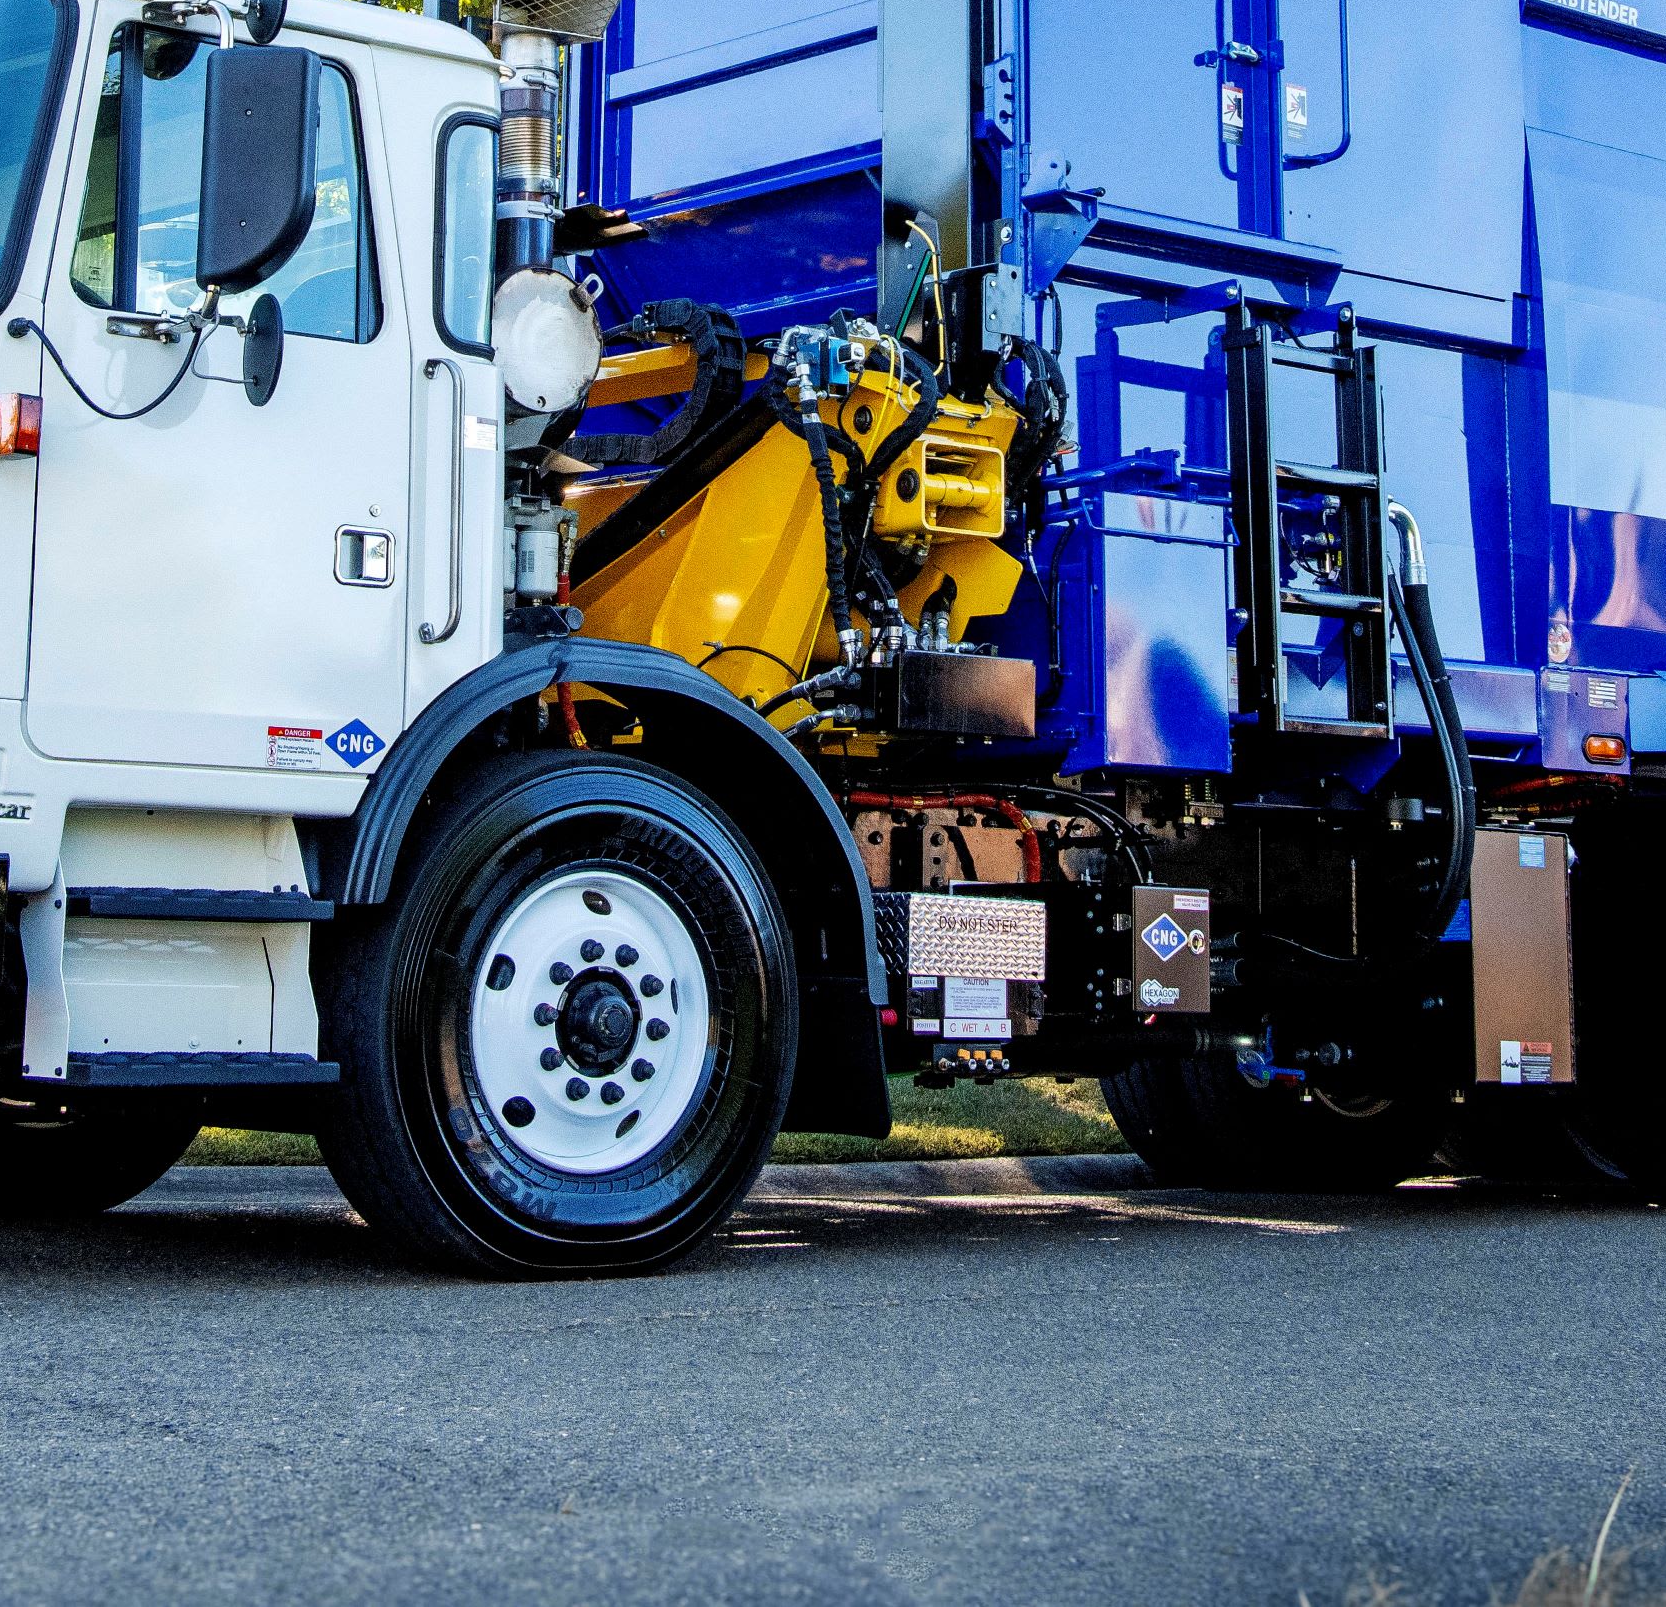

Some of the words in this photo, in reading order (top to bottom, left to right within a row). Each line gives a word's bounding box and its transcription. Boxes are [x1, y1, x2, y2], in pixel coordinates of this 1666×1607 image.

[284, 729, 311, 737] DANGER
[336, 733, 374, 754] CNG
[939, 915, 956, 930] DO
[958, 917, 984, 932] NOT
[987, 918, 1017, 933] STEP
[1151, 929, 1178, 947] CNG
[963, 978, 990, 986] CAUTION
[1144, 988, 1178, 997] HEXAGON
[949, 1023, 957, 1032] C
[961, 1023, 978, 1032] WET
[983, 1023, 991, 1032] A
[1000, 1023, 1007, 1032] B
